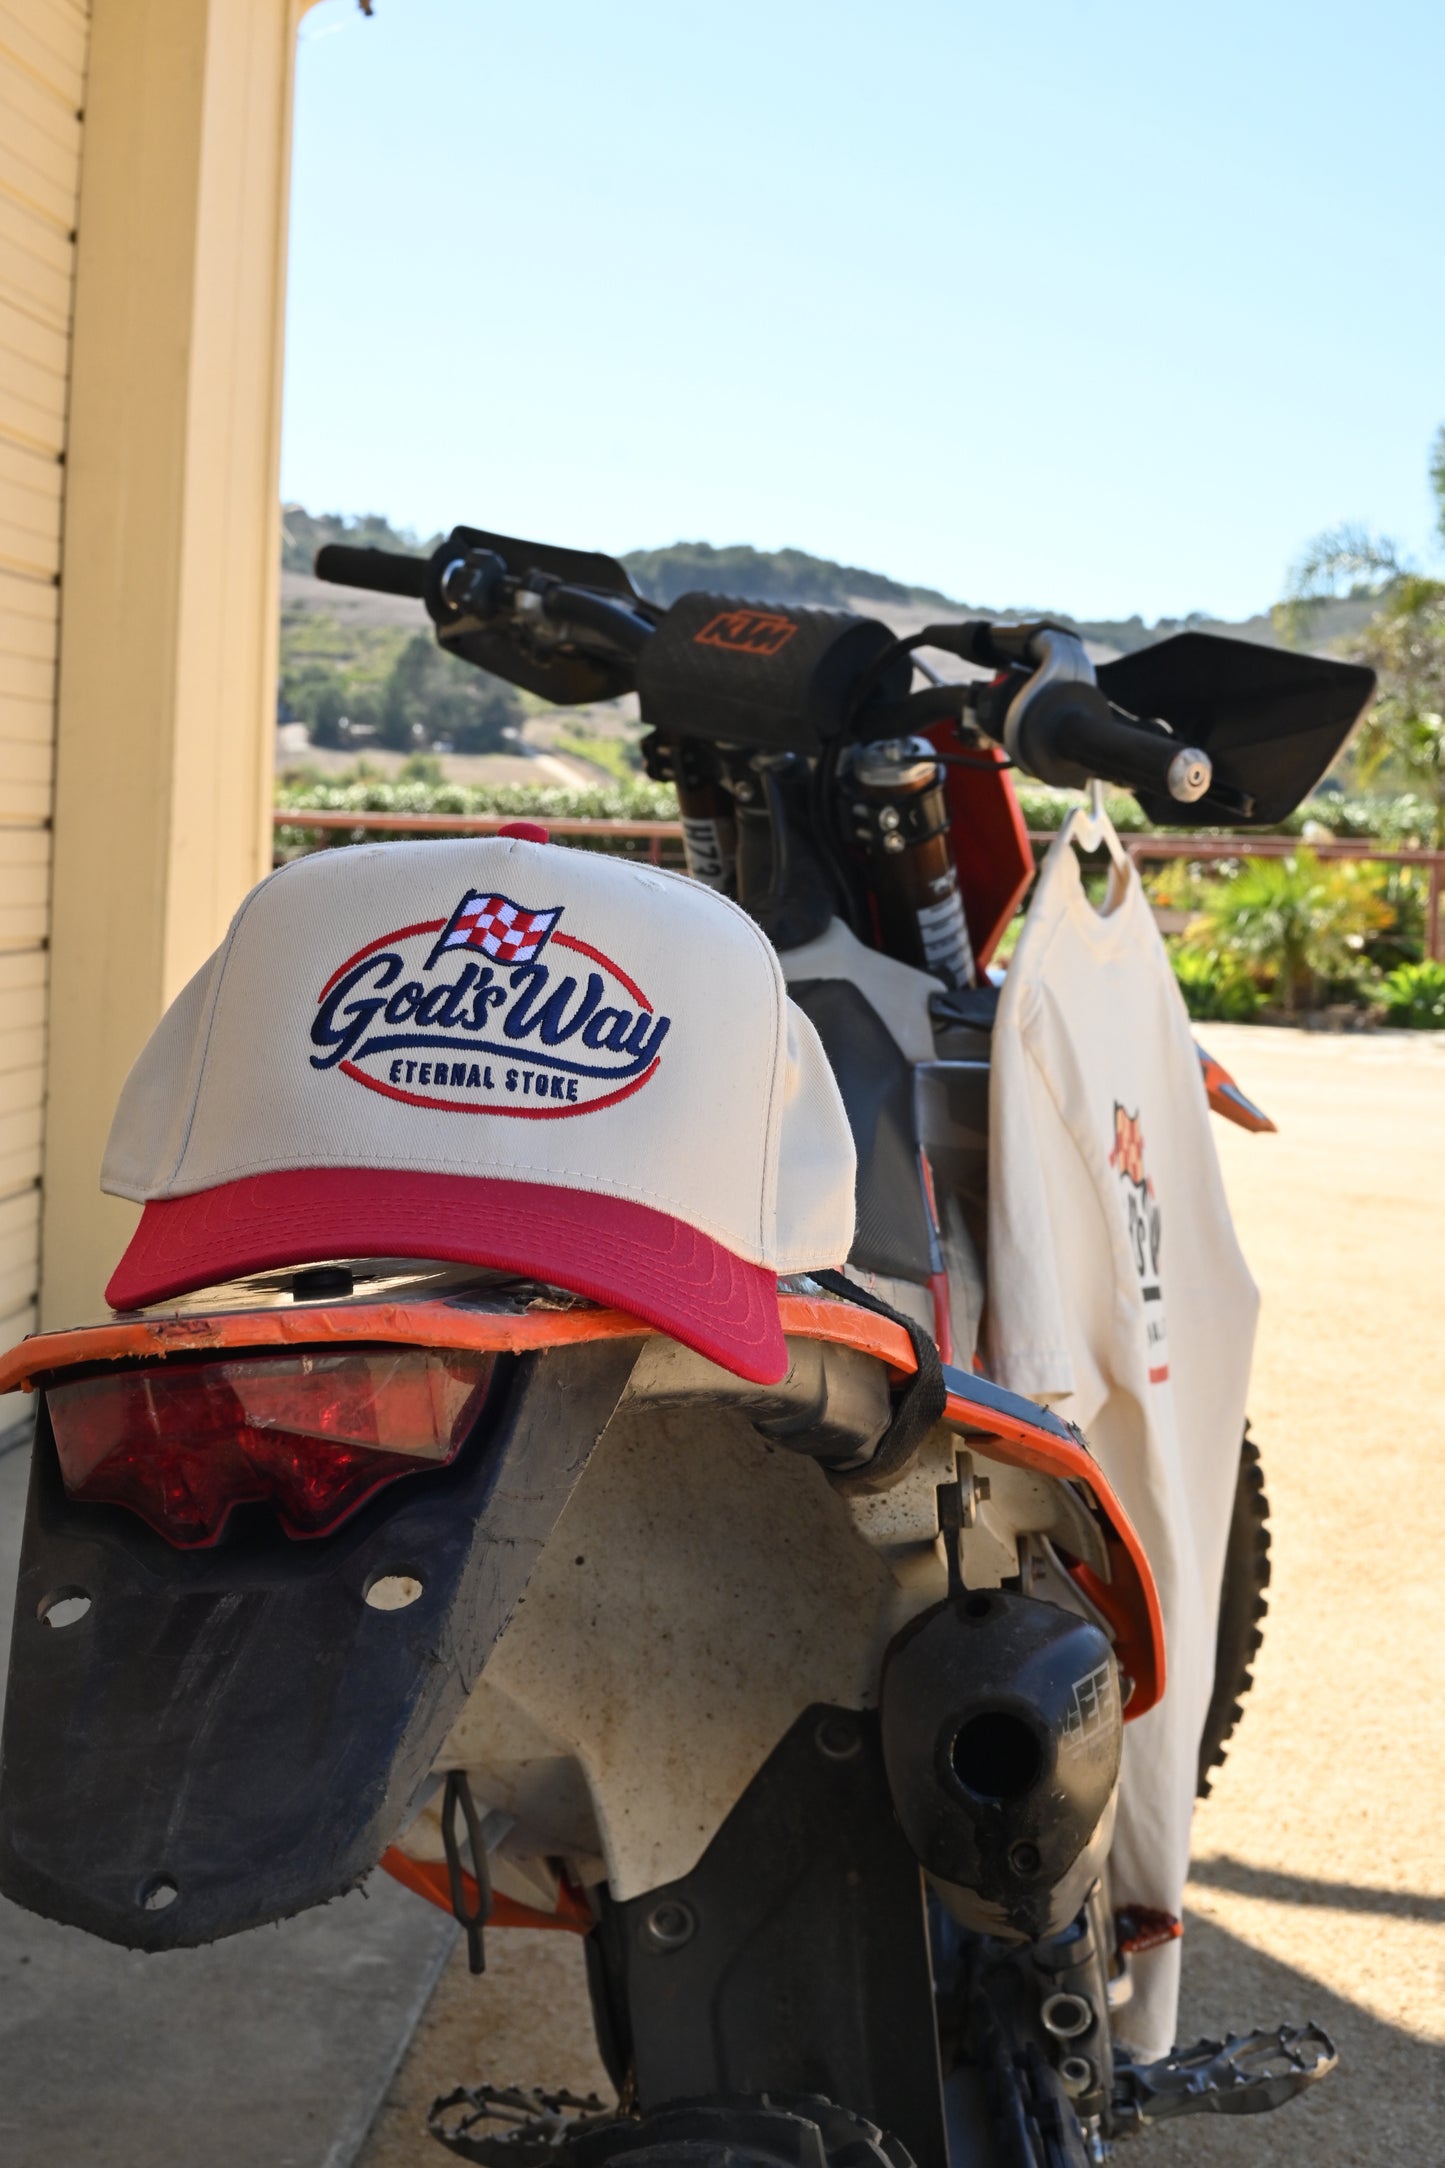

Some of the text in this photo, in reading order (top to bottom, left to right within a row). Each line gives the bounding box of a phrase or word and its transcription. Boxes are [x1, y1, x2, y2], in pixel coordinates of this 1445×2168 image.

[696, 610, 797, 654] KTM
[309, 952, 671, 1079] God's Way
[389, 1059, 579, 1102] ETERNAL STOKE
